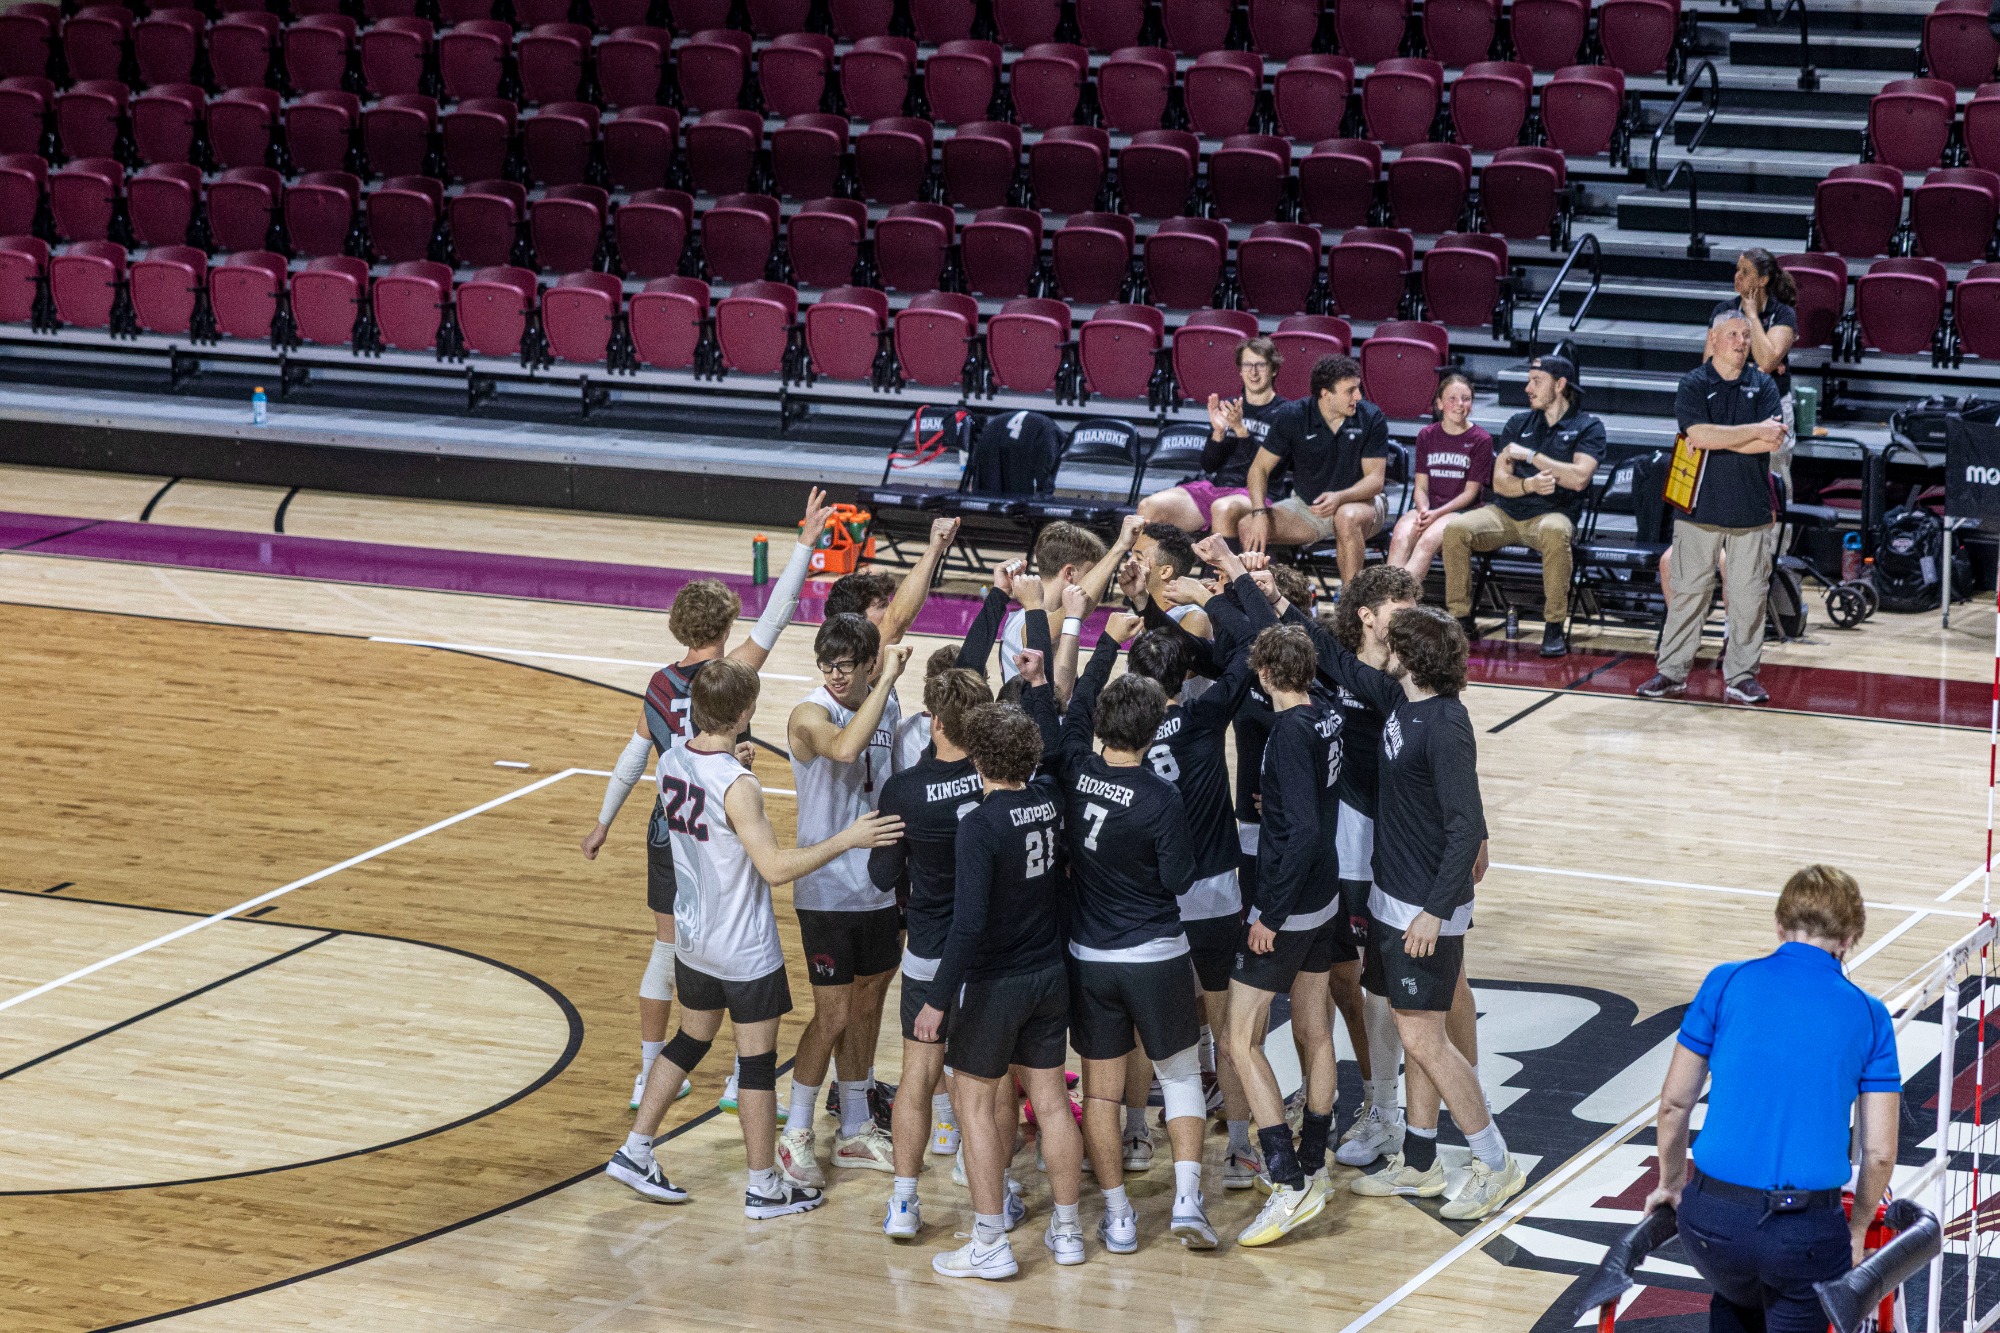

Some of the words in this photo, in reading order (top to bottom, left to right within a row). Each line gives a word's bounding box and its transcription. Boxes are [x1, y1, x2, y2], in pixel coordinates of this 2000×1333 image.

[1006, 410, 1029, 440] 4
[1074, 428, 1130, 449] ROANOKE
[1426, 453, 1472, 468] ROANOKE
[811, 553, 825, 569] G
[670, 697, 695, 749] 3
[863, 751, 874, 793] 1
[1147, 744, 1180, 781] 8
[662, 774, 710, 842] 22
[1076, 773, 1135, 807] HOUSER
[1083, 801, 1109, 852] 7
[1025, 826, 1055, 879] 21
